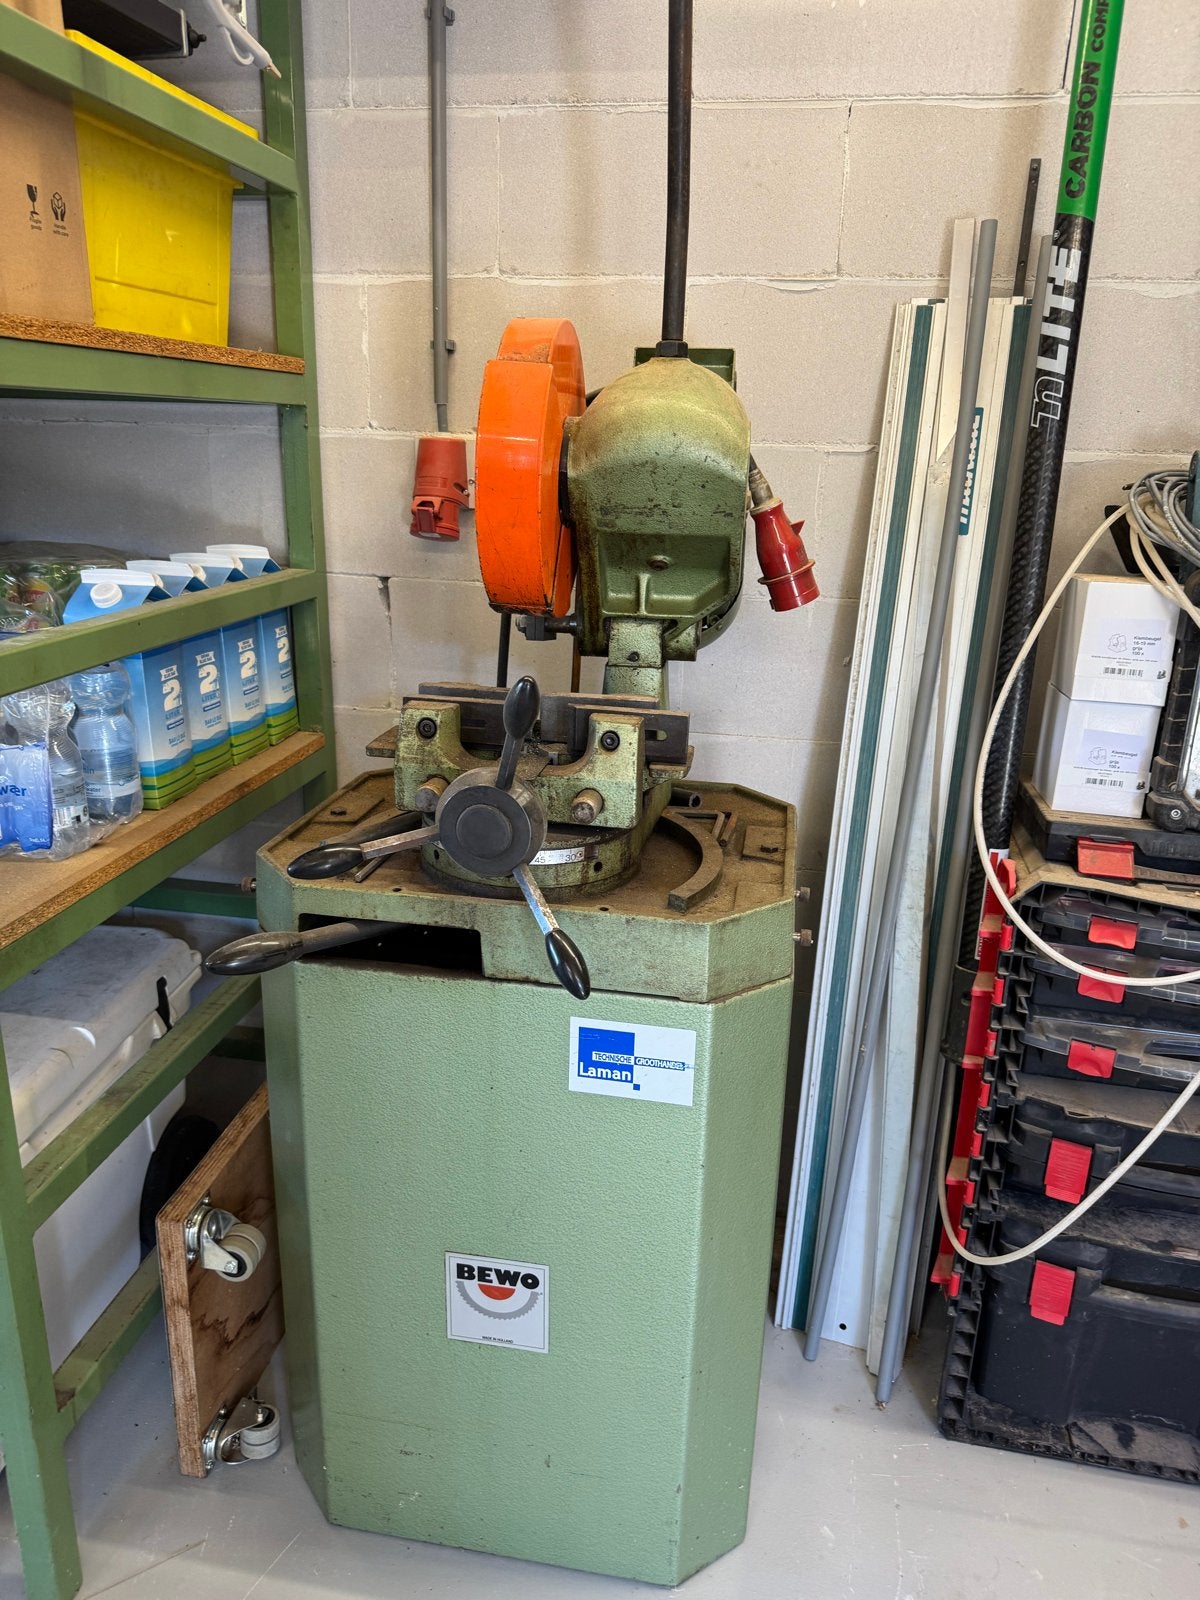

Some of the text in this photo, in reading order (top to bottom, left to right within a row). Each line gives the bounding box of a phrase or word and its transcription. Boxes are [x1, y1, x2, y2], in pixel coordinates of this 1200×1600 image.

[1065, 61, 1101, 199] CARBON
[240, 650, 258, 679] 2
[198, 664, 219, 695] 2
[162, 679, 182, 711] 2
[534, 853, 577, 864] 45 30
[579, 1061, 632, 1081] Laman
[594, 1052, 632, 1064] TECHNISCHE
[456, 1263, 540, 1290] BEWO
